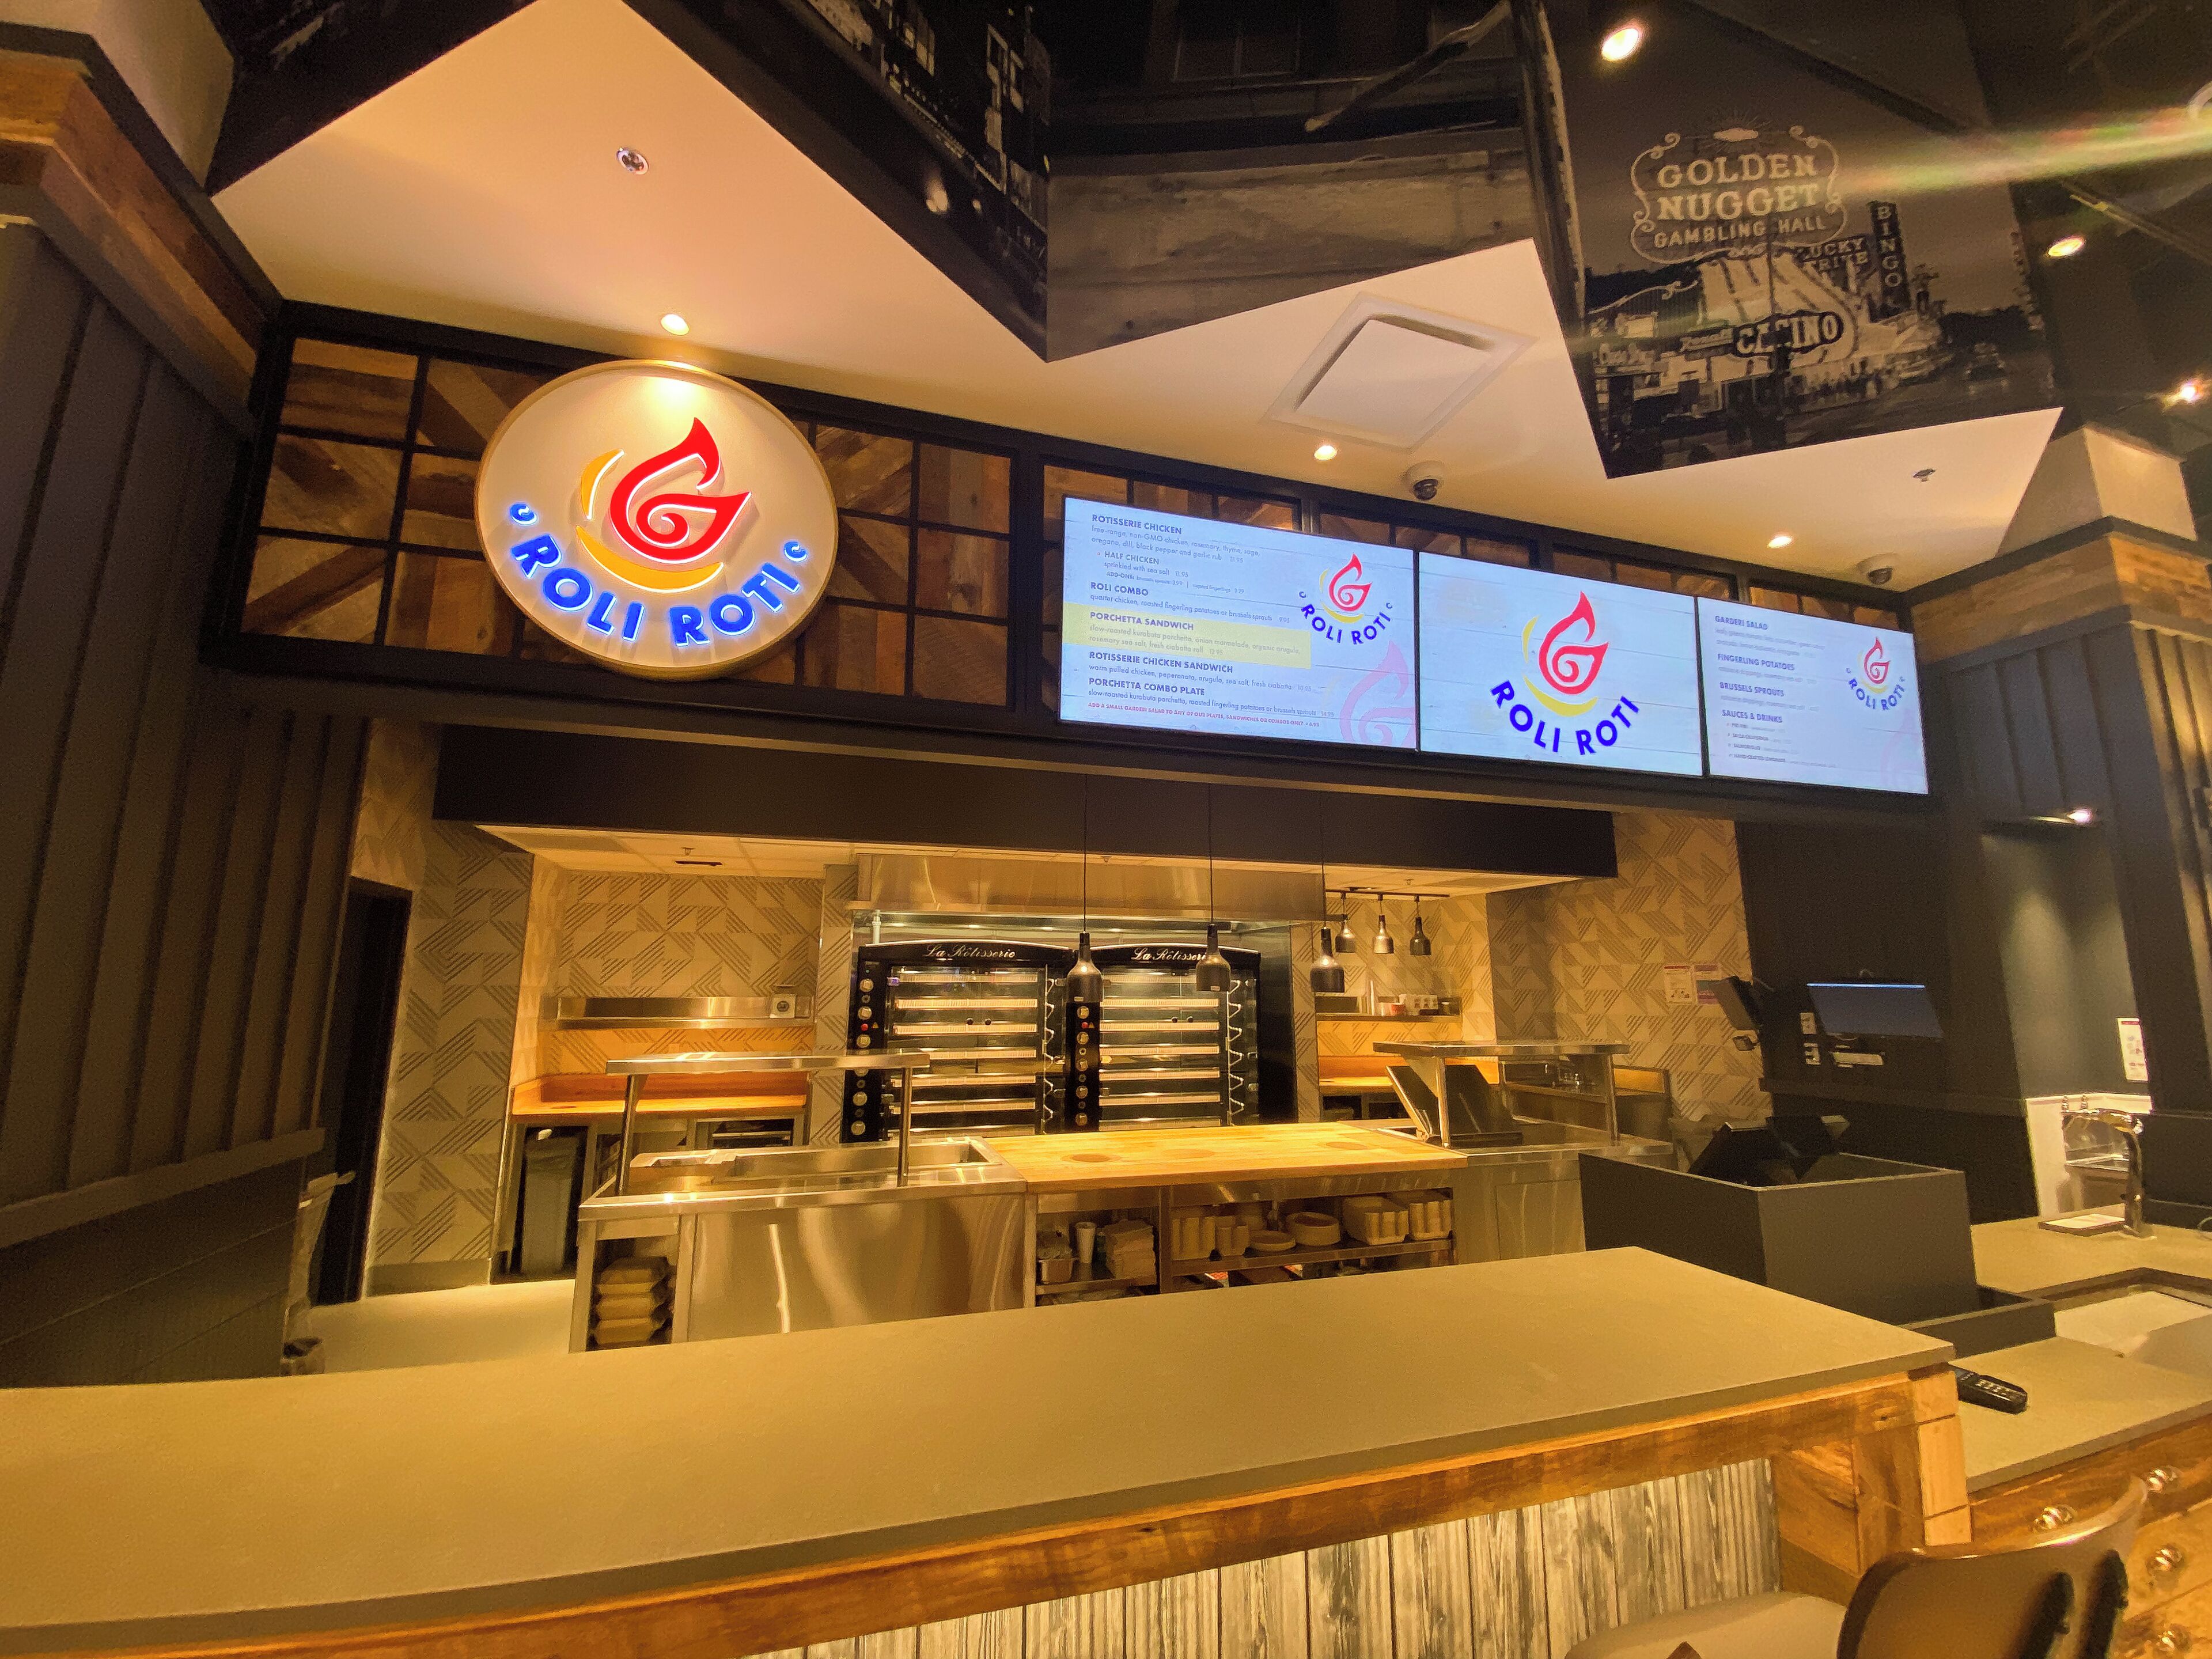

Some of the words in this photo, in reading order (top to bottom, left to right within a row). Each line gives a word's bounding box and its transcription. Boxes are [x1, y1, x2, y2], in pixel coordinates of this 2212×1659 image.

[1657, 153, 1816, 188] GOLDEN
[1657, 184, 1819, 221] NUGGET
[1654, 219, 1766, 248] GAMBLING
[1778, 215, 1827, 233] HALL
[1877, 205, 1902, 287] BINGO
[1092, 514, 1142, 528] ROTISSERIE
[1143, 522, 1182, 535] CHICKEN
[1091, 537, 1121, 547] oregano,
[1123, 539, 1134, 548] dill,
[1136, 542, 1153, 551] black
[1156, 547, 1178, 555] pepper
[1193, 550, 1210, 559] garlic
[1092, 525, 1127, 537] free-range,
[1130, 532, 1163, 542] non-GMO
[1164, 536, 1189, 546] chicken,
[1191, 541, 1221, 551] rosemary,
[1223, 545, 1243, 554] thyme,
[1104, 551, 1124, 560] HALF
[1125, 554, 1160, 565] CHICKEN
[1104, 562, 1131, 571] sprinkled
[1159, 567, 1170, 576] salt
[511, 534, 645, 642] ROLI
[669, 562, 800, 646] ROTI
[1090, 581, 1112, 592] ROLI
[1114, 585, 1149, 596] COMBO
[1090, 594, 1113, 603] quarter
[1114, 596, 1139, 606] chicken,
[1141, 600, 1164, 608] roasted
[1164, 601, 1192, 613] fingerling
[1194, 607, 1220, 616] potatoes
[1229, 609, 1252, 619] brussels
[1252, 613, 1272, 622] sprouts
[1089, 612, 1142, 624] PORCHETTA
[1145, 618, 1194, 631] SANDWICH
[1301, 604, 1342, 644] ROLI
[1352, 612, 1389, 645] ROTI
[1747, 619, 1768, 630] SALAD
[1089, 624, 1131, 635] slow-roasted
[1132, 628, 1161, 639] kurabuta
[1162, 632, 1193, 643] porchetta,
[1214, 639, 1250, 649] marmalade,
[1252, 643, 1275, 652] organic
[1276, 645, 1301, 655] arugula,
[1089, 635, 1120, 645] rosemary
[1134, 639, 1147, 648] salt,
[1149, 641, 1164, 650] fresh
[1165, 643, 1192, 653] ciabatta
[1089, 651, 1141, 664] ROTISSERIE
[1142, 657, 1181, 668] CHICKEN
[1183, 661, 1233, 673] SANDWICH
[1717, 653, 1760, 665] FINGERLING
[1761, 660, 1796, 671] POTATOES
[1088, 677, 1141, 690] PORCHETTA
[1143, 683, 1178, 693] COMBO
[1180, 686, 1205, 696] PLATE
[1109, 665, 1129, 674] pulled
[1131, 668, 1157, 677] chicken,
[1158, 672, 1198, 682] peperonata,
[1199, 676, 1224, 685] arugula,
[1251, 679, 1266, 688] fresh
[1267, 682, 1292, 691] ciabatta
[1719, 681, 1753, 693] BRUSSELS
[1754, 686, 1785, 697] SPROUTS
[1088, 689, 1128, 699] slow-roasted
[1130, 692, 1156, 702] kurabuta
[1157, 695, 1187, 706] porchetta,
[1188, 698, 1210, 706] roasted
[1211, 699, 1238, 711] fingerling
[1240, 703, 1265, 713] potatoes
[1273, 705, 1295, 714] brussels
[1296, 709, 1316, 717] sprouts
[1849, 677, 1876, 710] ROLI
[1880, 684, 1905, 711] ROTI
[1226, 714, 1259, 722] SANDWICHES
[1490, 680, 1560, 753] ROLI
[1575, 696, 1640, 755] ROTI
[1722, 709, 1749, 720] SAUCES
[1756, 713, 1783, 724] DRINKS
[923, 944, 946, 958] La
[1131, 947, 1152, 961] La
[1153, 948, 1208, 961] Rôtisseri
